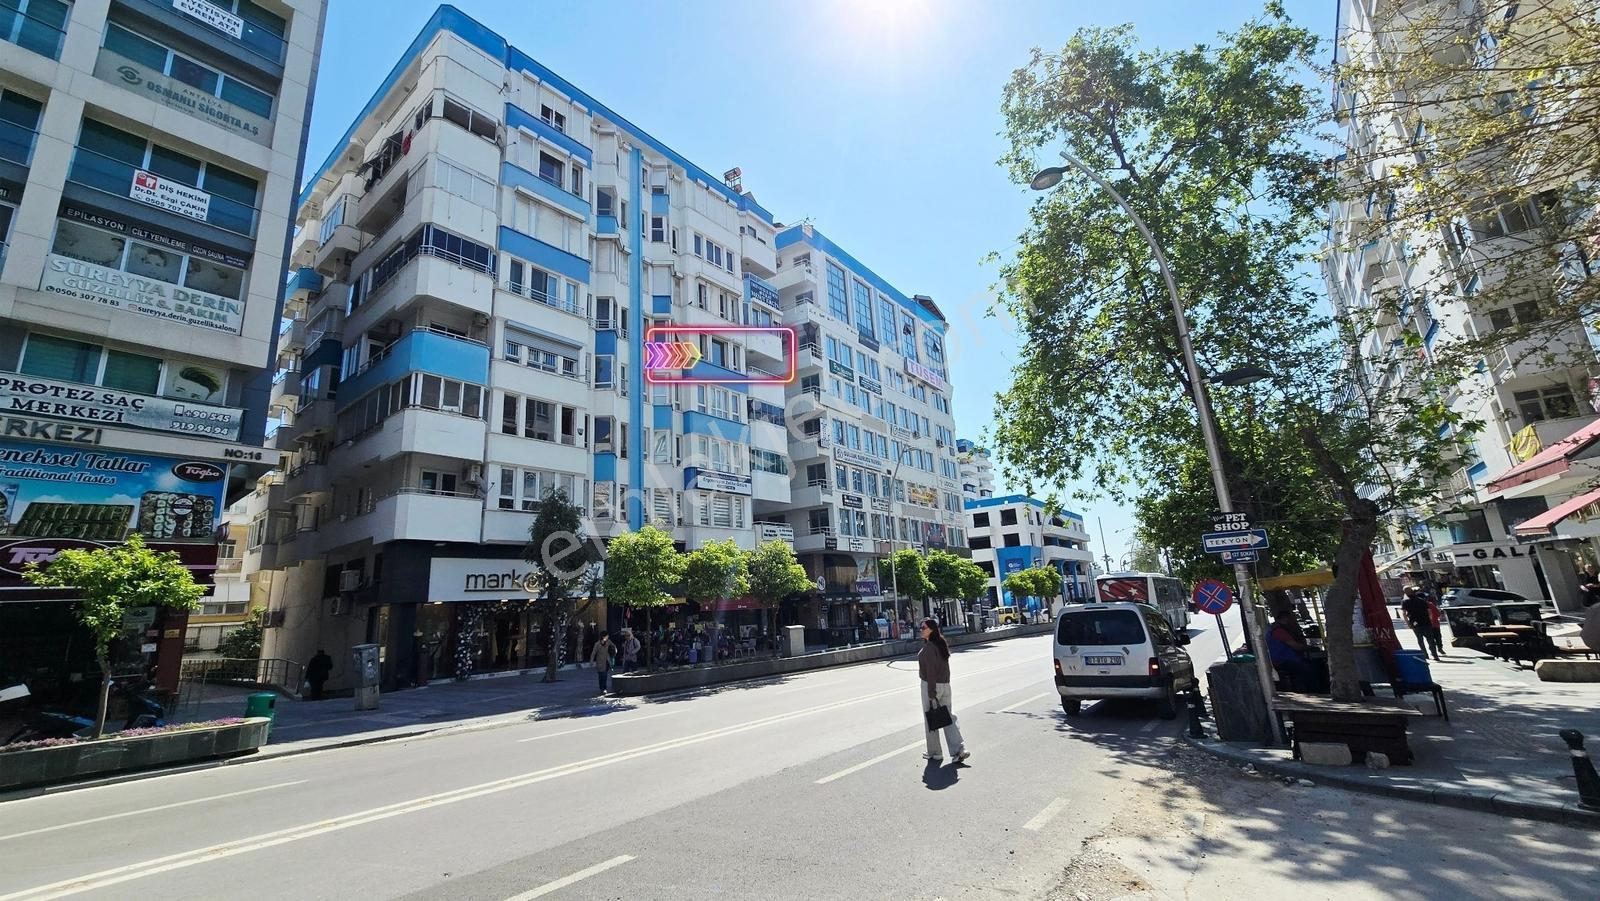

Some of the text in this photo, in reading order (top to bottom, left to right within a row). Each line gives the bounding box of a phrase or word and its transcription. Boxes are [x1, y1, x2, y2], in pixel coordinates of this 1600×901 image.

[181, 2, 215, 22] EVREN
[218, 21, 237, 33] ATA
[147, 81, 196, 109] OSMANLI
[183, 88, 223, 109] ANTALYA
[160, 194, 178, 204] Ezgi
[167, 203, 182, 212] 707
[67, 208, 125, 231] EPİLASYON
[131, 227, 187, 249] CİLT YENİLEME
[207, 250, 226, 261] SAUNA
[50, 257, 241, 316] SÜREYYA DERİN
[55, 287, 120, 307] 0506 307 78 83
[174, 305, 229, 324] BAKIM
[0, 378, 145, 413] PROTEZ SAÇ
[10, 397, 125, 423] MERKEZİ
[185, 409, 231, 422] +90 545
[171, 421, 229, 435] 919 94 94
[83, 452, 151, 474] Tatlar
[224, 448, 263, 461] NO:16
[0, 466, 117, 485] raditional Tastes
[1214, 521, 1250, 532] SHOP
[1225, 513, 1246, 522] PET
